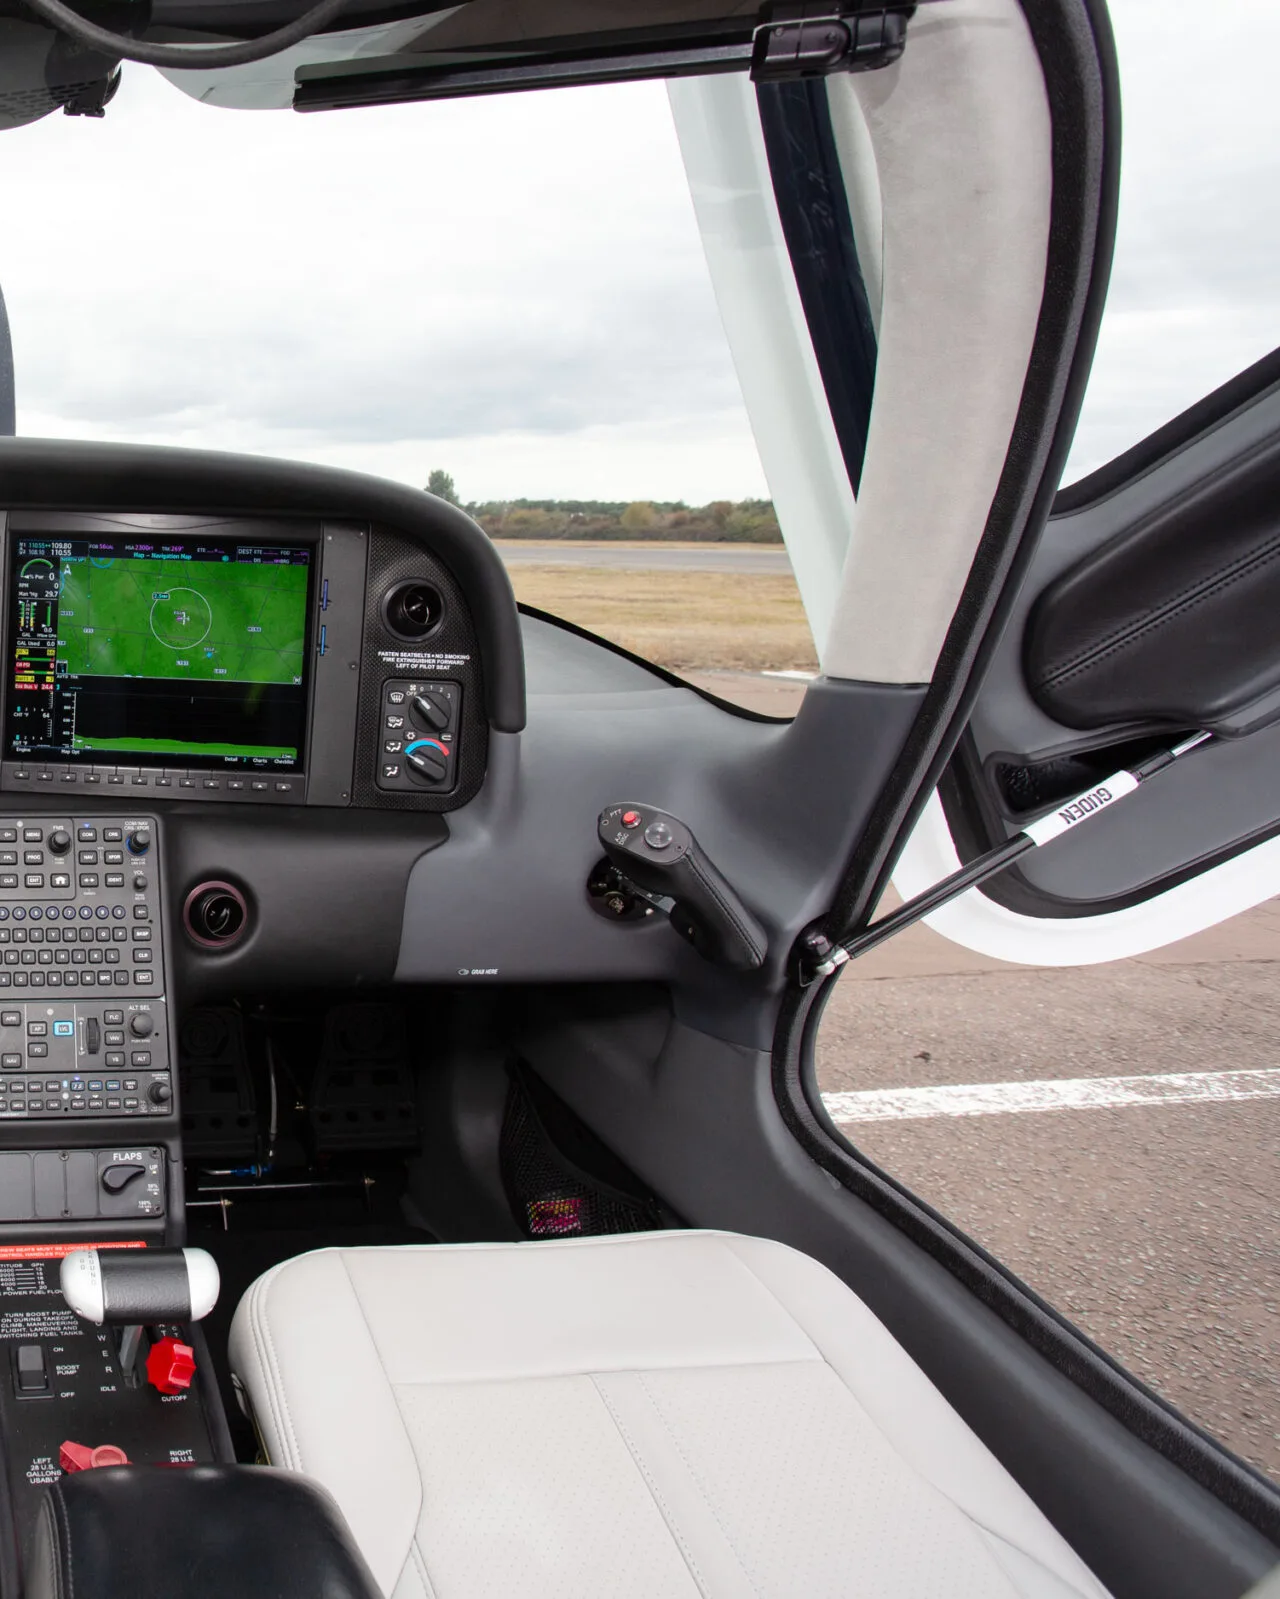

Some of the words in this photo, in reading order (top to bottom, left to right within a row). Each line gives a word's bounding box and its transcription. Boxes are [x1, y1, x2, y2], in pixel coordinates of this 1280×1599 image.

[609, 808, 622, 818] PTT
[112, 1152, 142, 1161] FLAPS
[26, 1320, 79, 1328] MANEUVERING
[161, 1394, 188, 1402] CUTOFF
